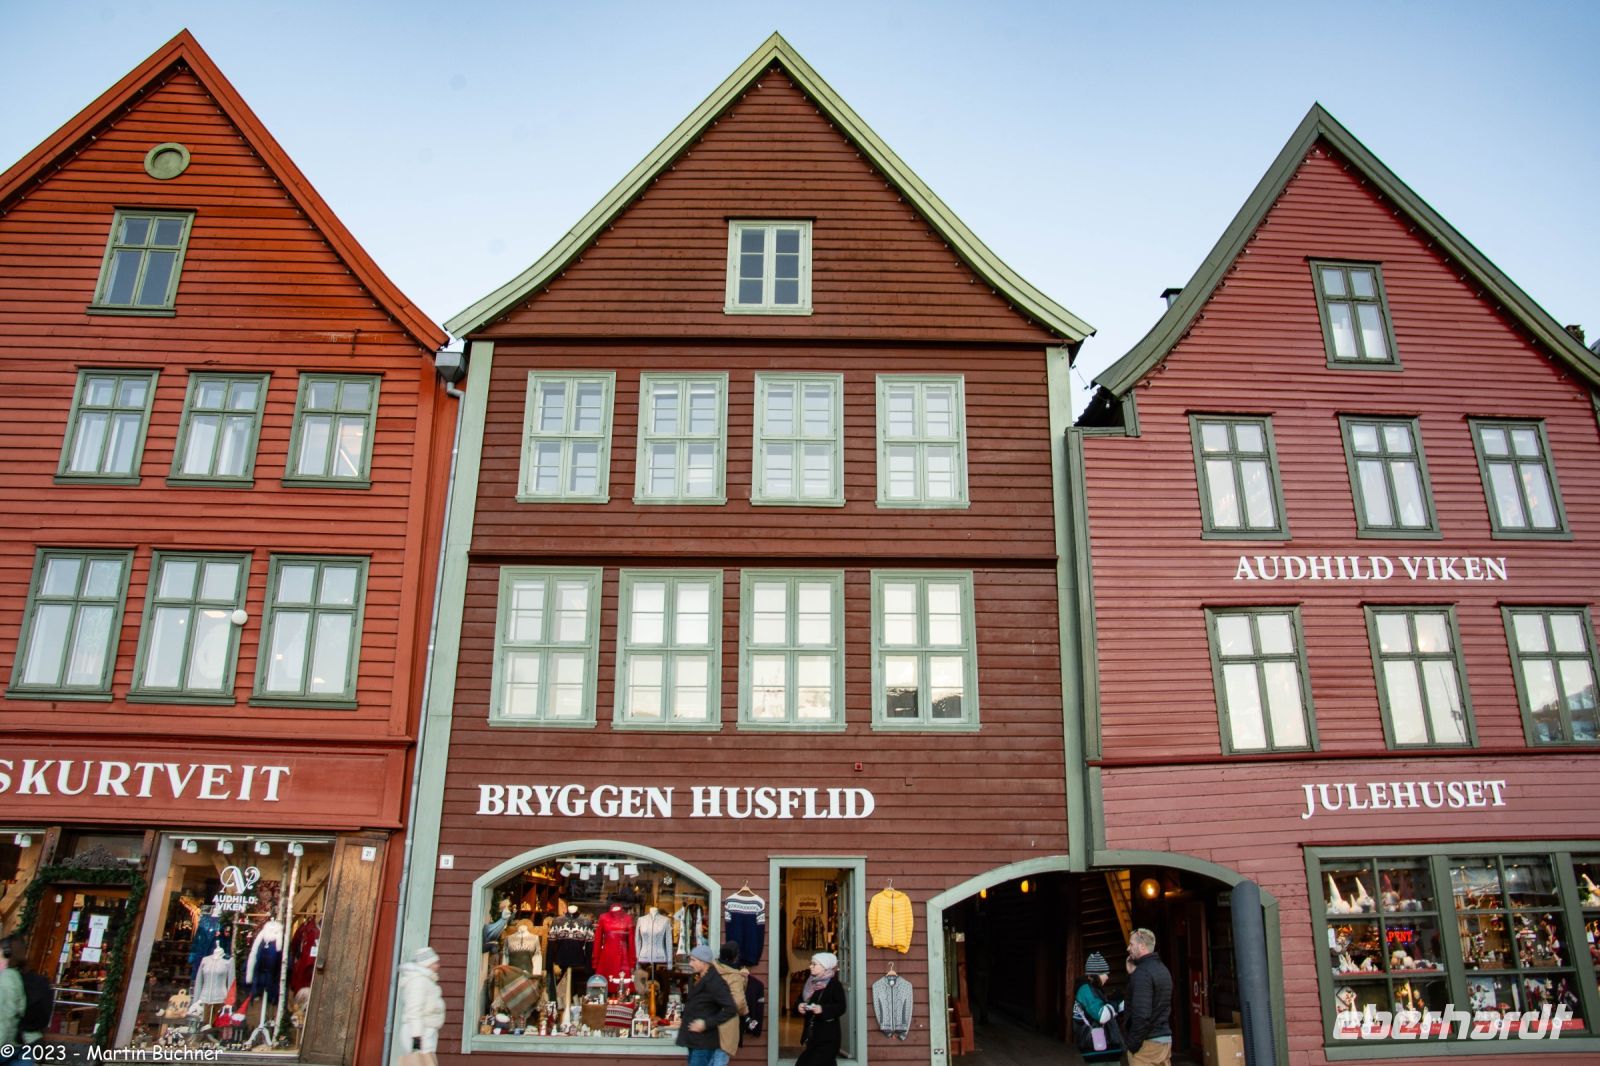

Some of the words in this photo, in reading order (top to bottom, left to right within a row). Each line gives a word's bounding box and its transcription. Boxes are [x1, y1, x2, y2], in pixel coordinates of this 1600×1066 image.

[1232, 556, 1394, 581] AUDHILD
[1398, 557, 1507, 581] VIKEN
[0, 759, 290, 801] SKURTVEIT
[476, 784, 675, 818] BRYGGEN
[689, 786, 875, 819] HUSFLID
[1301, 779, 1506, 820] JULEHUSET
[212, 895, 256, 904] AUDHILD
[215, 903, 247, 911] VIKEN
